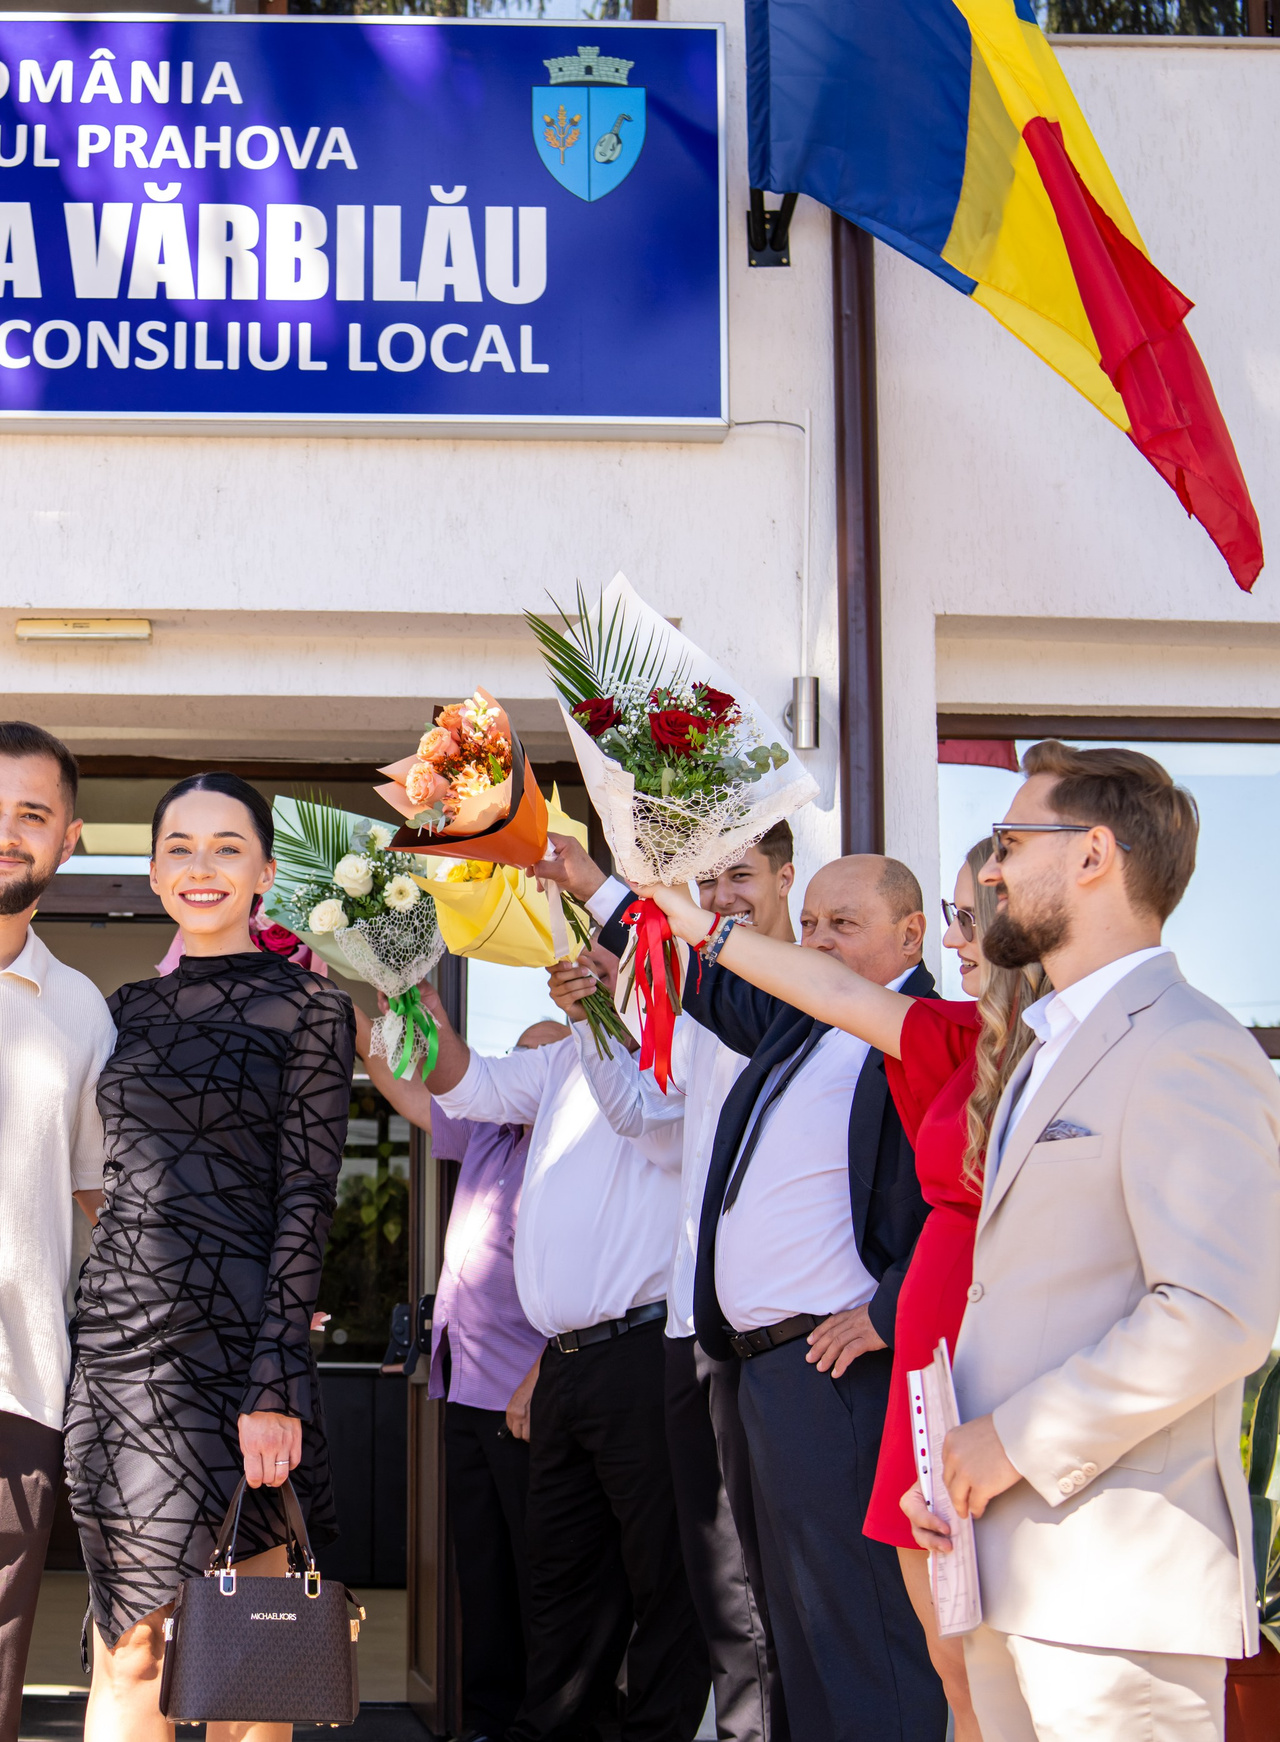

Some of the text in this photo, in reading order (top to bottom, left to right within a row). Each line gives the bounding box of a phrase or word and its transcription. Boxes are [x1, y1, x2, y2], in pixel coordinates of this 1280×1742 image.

[77, 124, 358, 171] PRAHOVA
[63, 181, 547, 305] VĂRBILĂU
[348, 322, 550, 374] LOCAL
